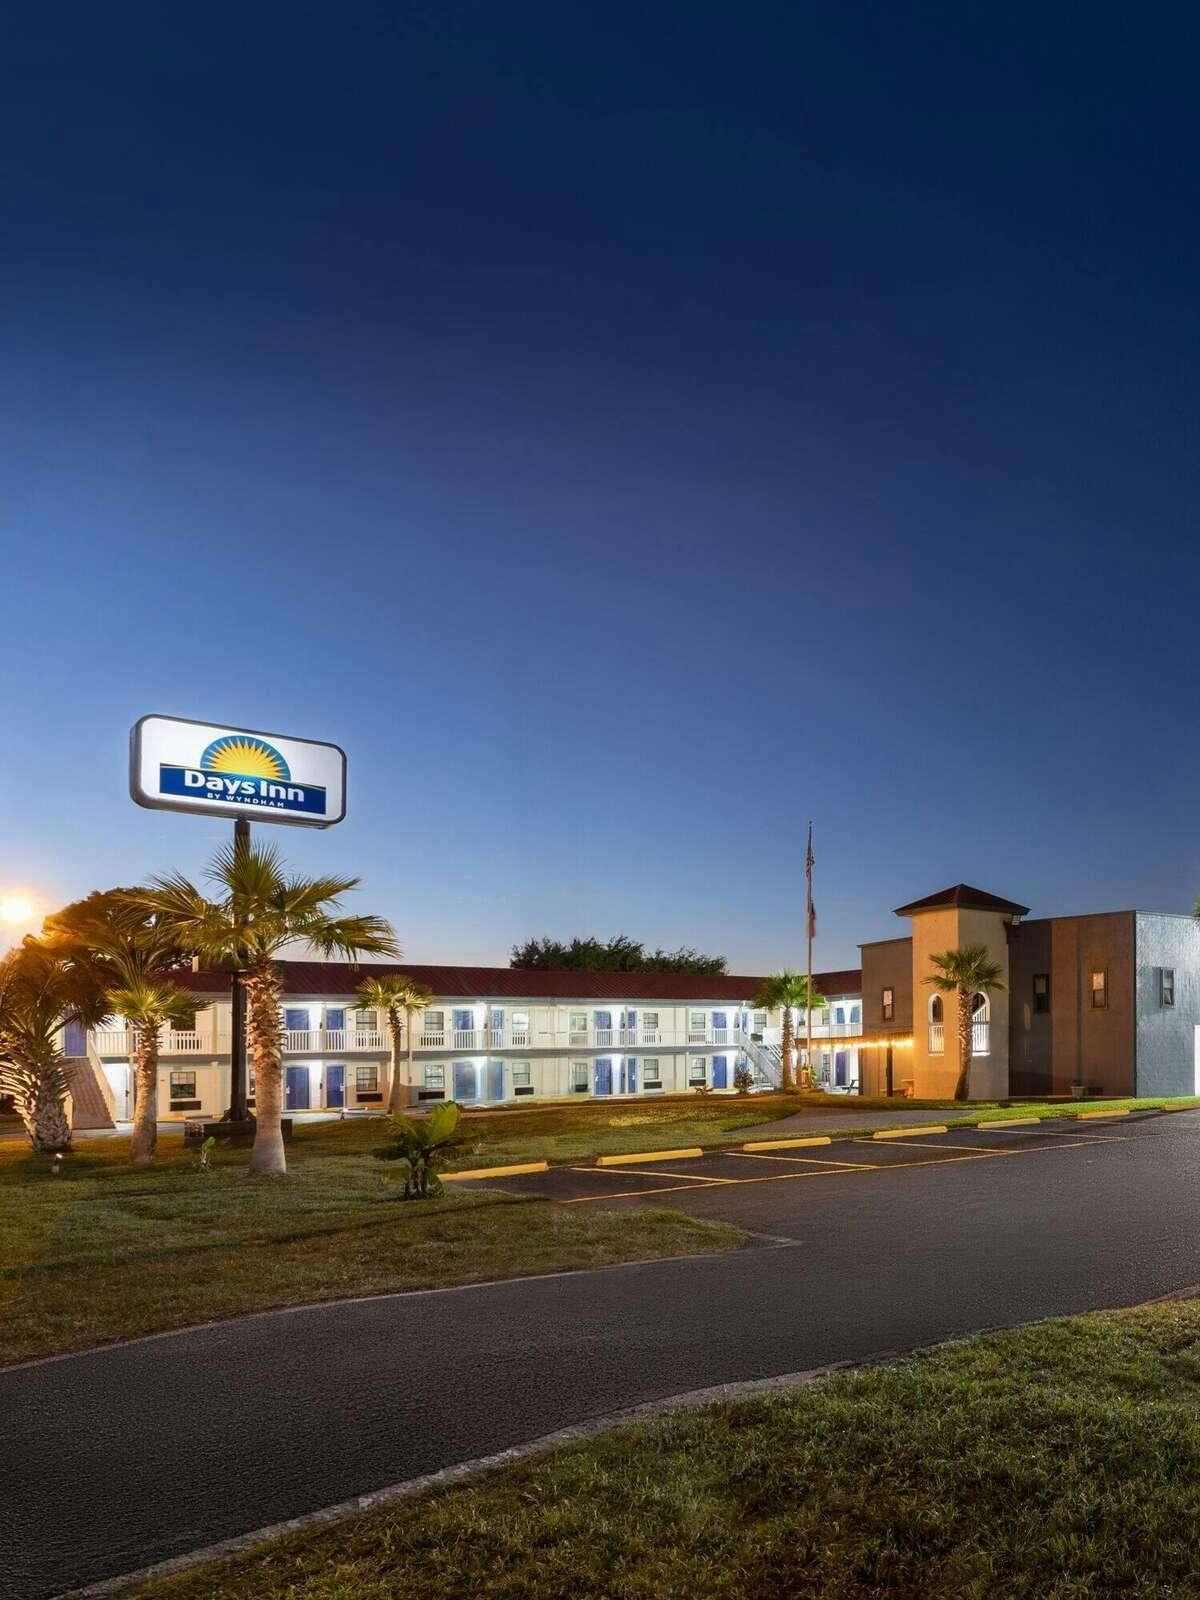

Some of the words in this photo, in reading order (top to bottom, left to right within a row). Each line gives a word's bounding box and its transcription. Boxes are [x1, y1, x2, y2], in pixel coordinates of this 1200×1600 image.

[184, 769, 256, 795] Days
[260, 780, 305, 802] Inn
[226, 795, 285, 808] WYNDHAM
